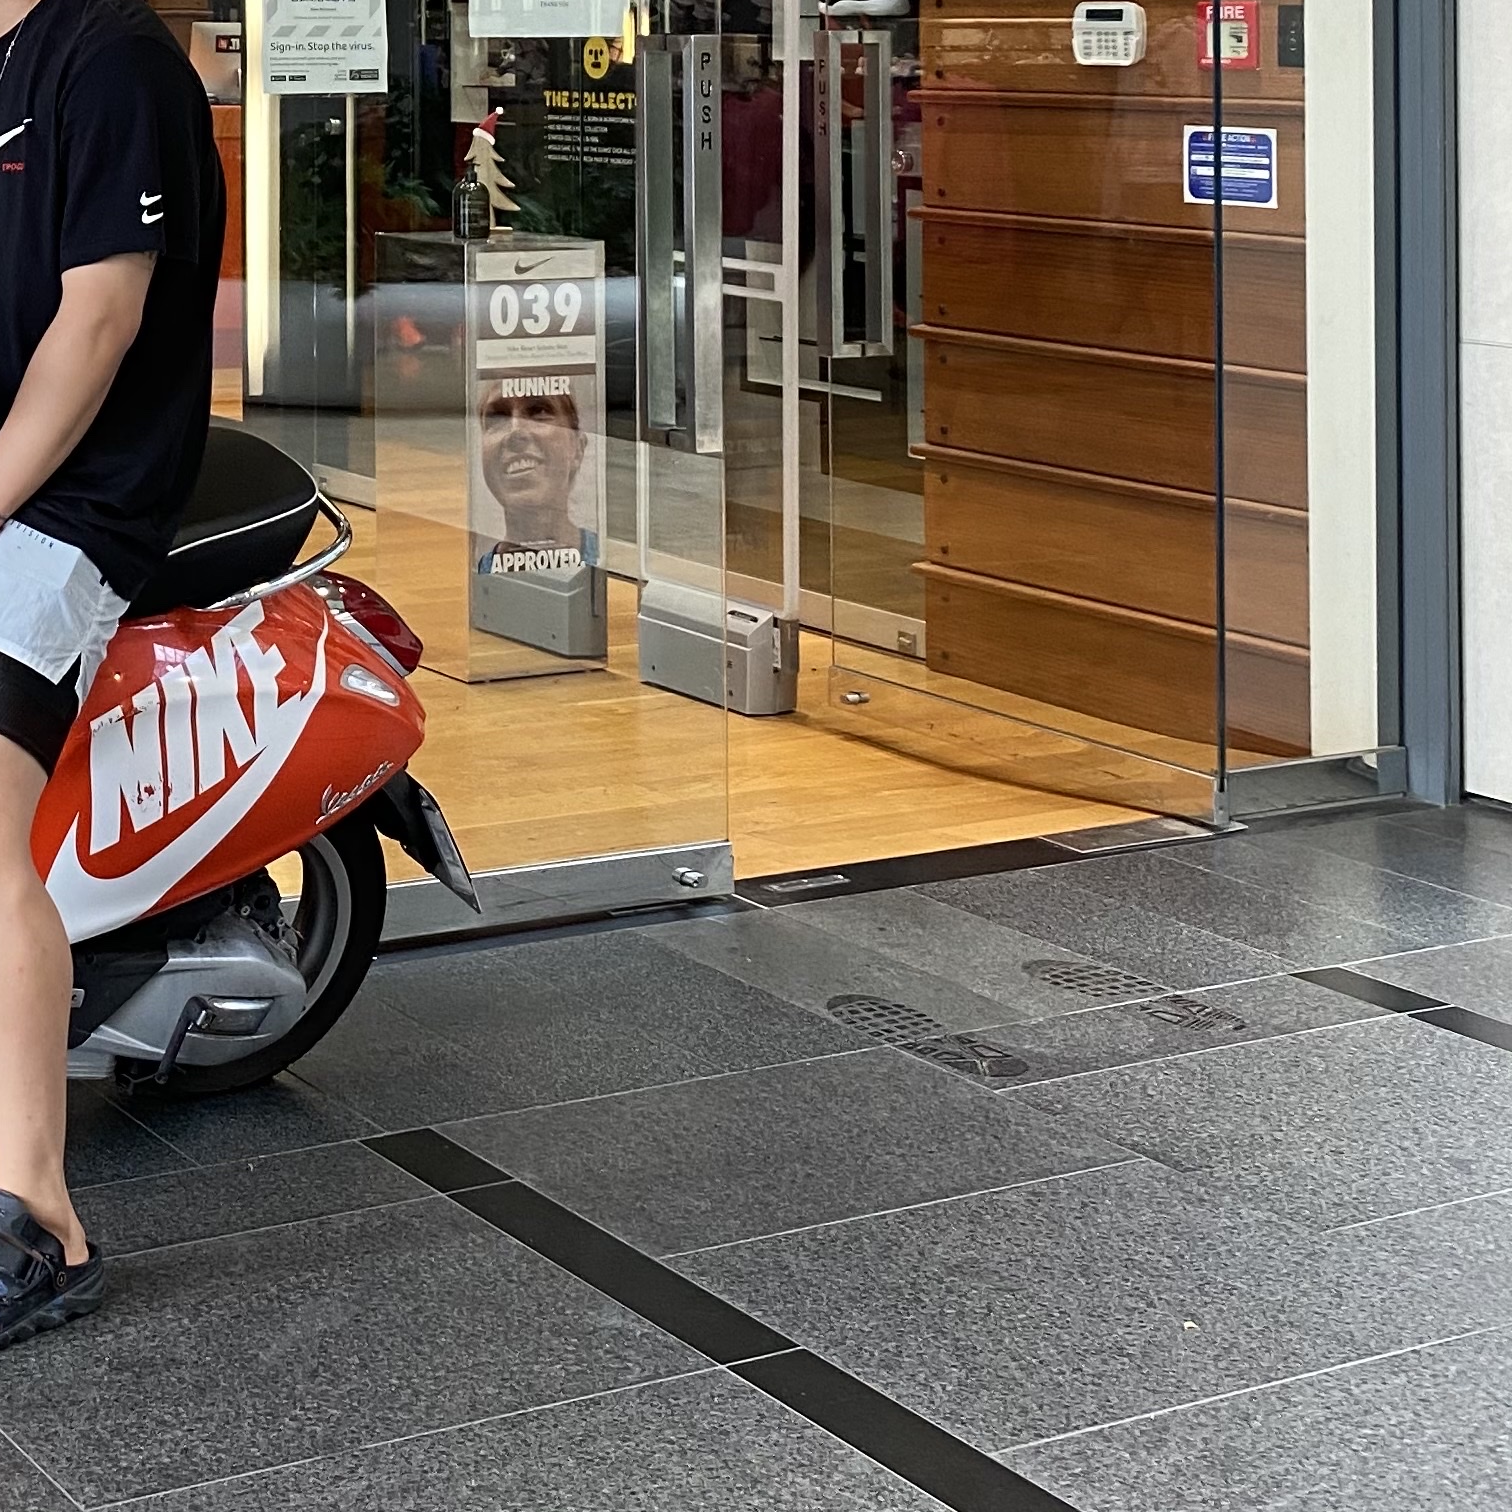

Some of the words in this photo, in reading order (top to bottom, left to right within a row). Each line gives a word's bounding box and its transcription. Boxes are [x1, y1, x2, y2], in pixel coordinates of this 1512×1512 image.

[1206, 5, 1245, 20] FIRE
[307, 42, 330, 52] Stop
[331, 42, 348, 52] the
[349, 42, 376, 52] virus.
[543, 90, 570, 108] THE
[572, 91, 637, 110] COLLECT
[700, 51, 713, 151] PUSH
[489, 282, 582, 337] 039
[501, 375, 571, 398] RUNNER
[491, 548, 586, 574] APPROVED.
[90, 599, 302, 856] NIKE
